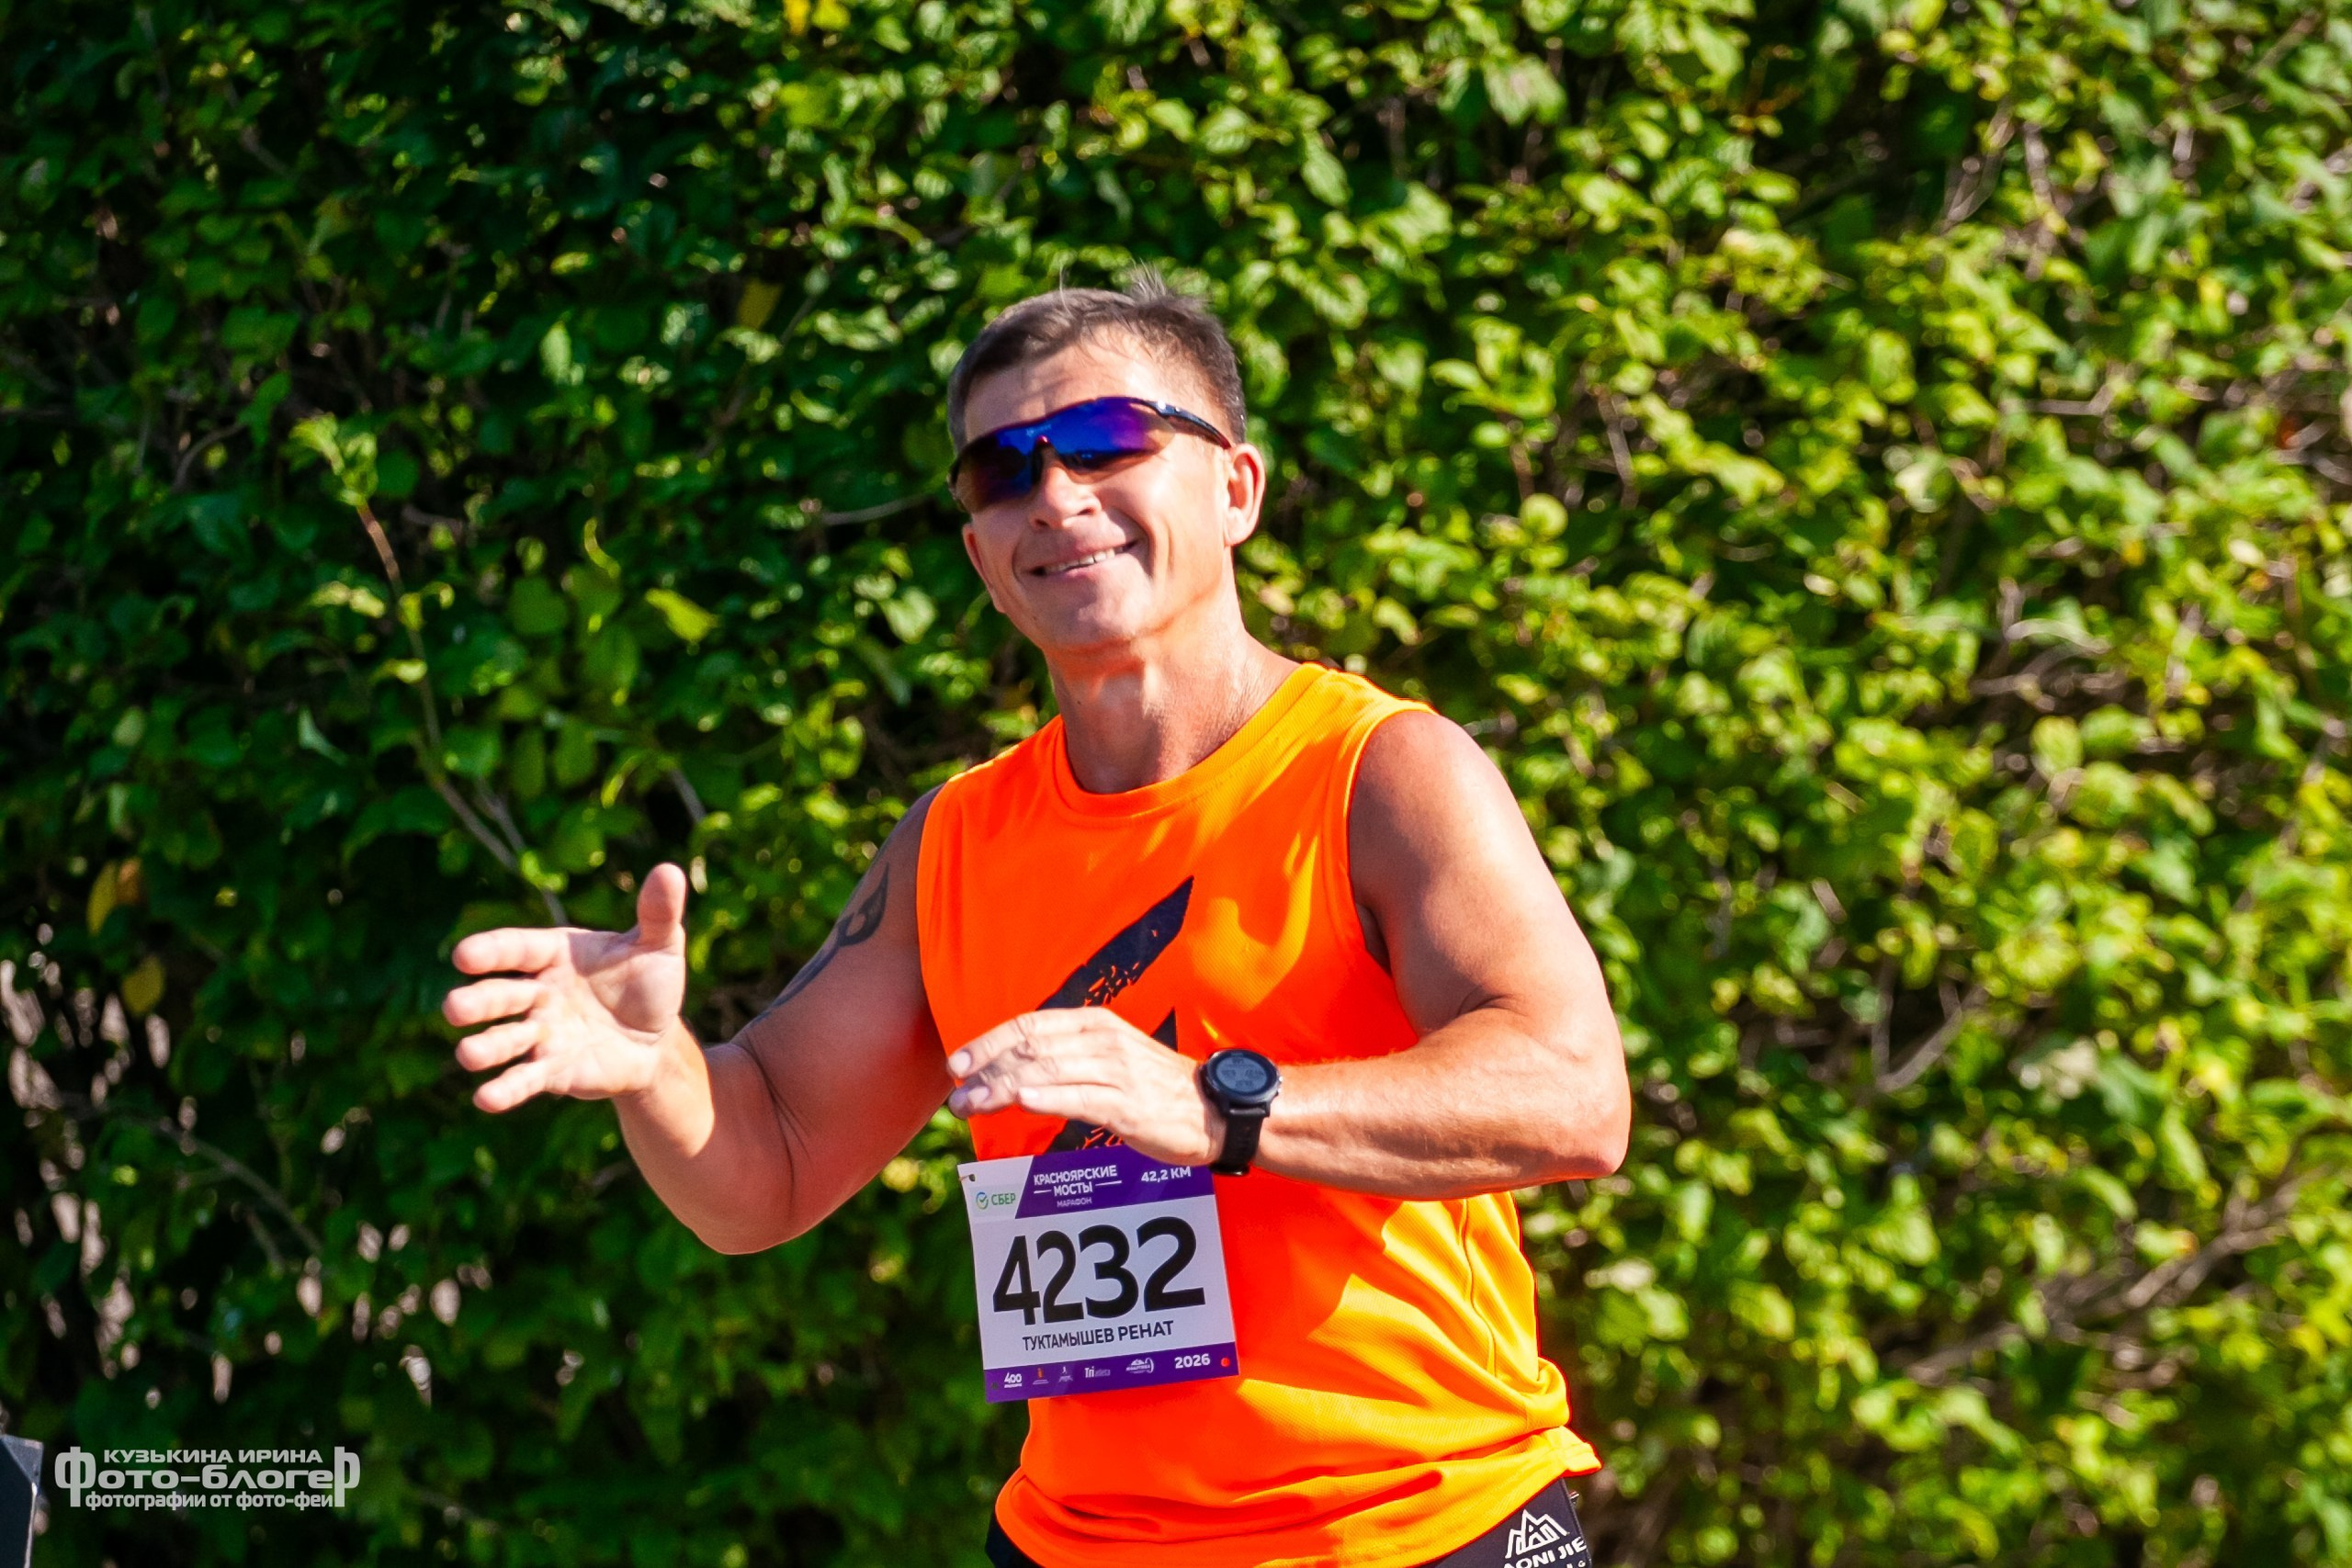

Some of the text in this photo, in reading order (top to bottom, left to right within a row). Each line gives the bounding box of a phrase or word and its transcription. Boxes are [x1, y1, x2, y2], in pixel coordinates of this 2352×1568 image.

[1034, 1165, 1118, 1186] КРАСНОЯРСКИЕ
[1141, 1169, 1169, 1184] 42,2
[1054, 1182, 1093, 1197] МОСТЫ
[991, 1192, 1016, 1206] СБЕР
[1057, 1197, 1092, 1208] МАРАФОН
[992, 1216, 1206, 1325] 4232
[1023, 1320, 1175, 1351] ТУКТАМЫШЕВ РЕНАТ
[1174, 1353, 1211, 1369] 2026
[1004, 1371, 1023, 1383] 400
